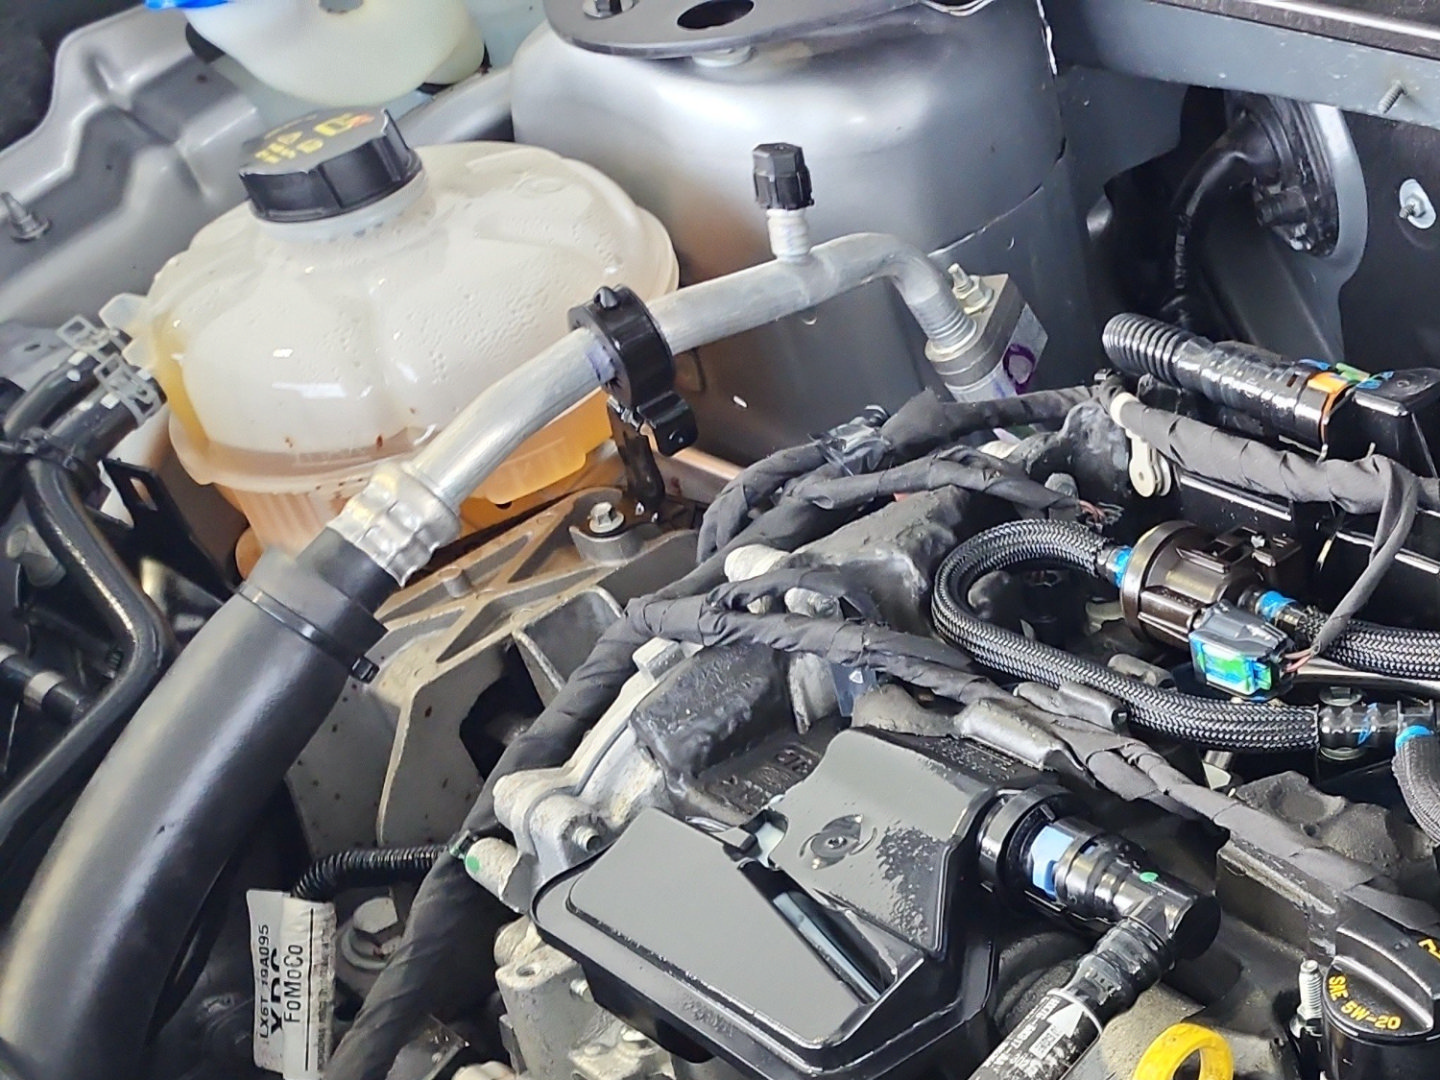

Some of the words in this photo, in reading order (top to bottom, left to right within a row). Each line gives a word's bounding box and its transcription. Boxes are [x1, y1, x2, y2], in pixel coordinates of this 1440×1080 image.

[283, 943, 304, 1024] FoMoCo
[1328, 975, 1349, 1001] SAE
[1340, 1000, 1402, 1030] 5W-20
[259, 995, 270, 1039] LX6T
